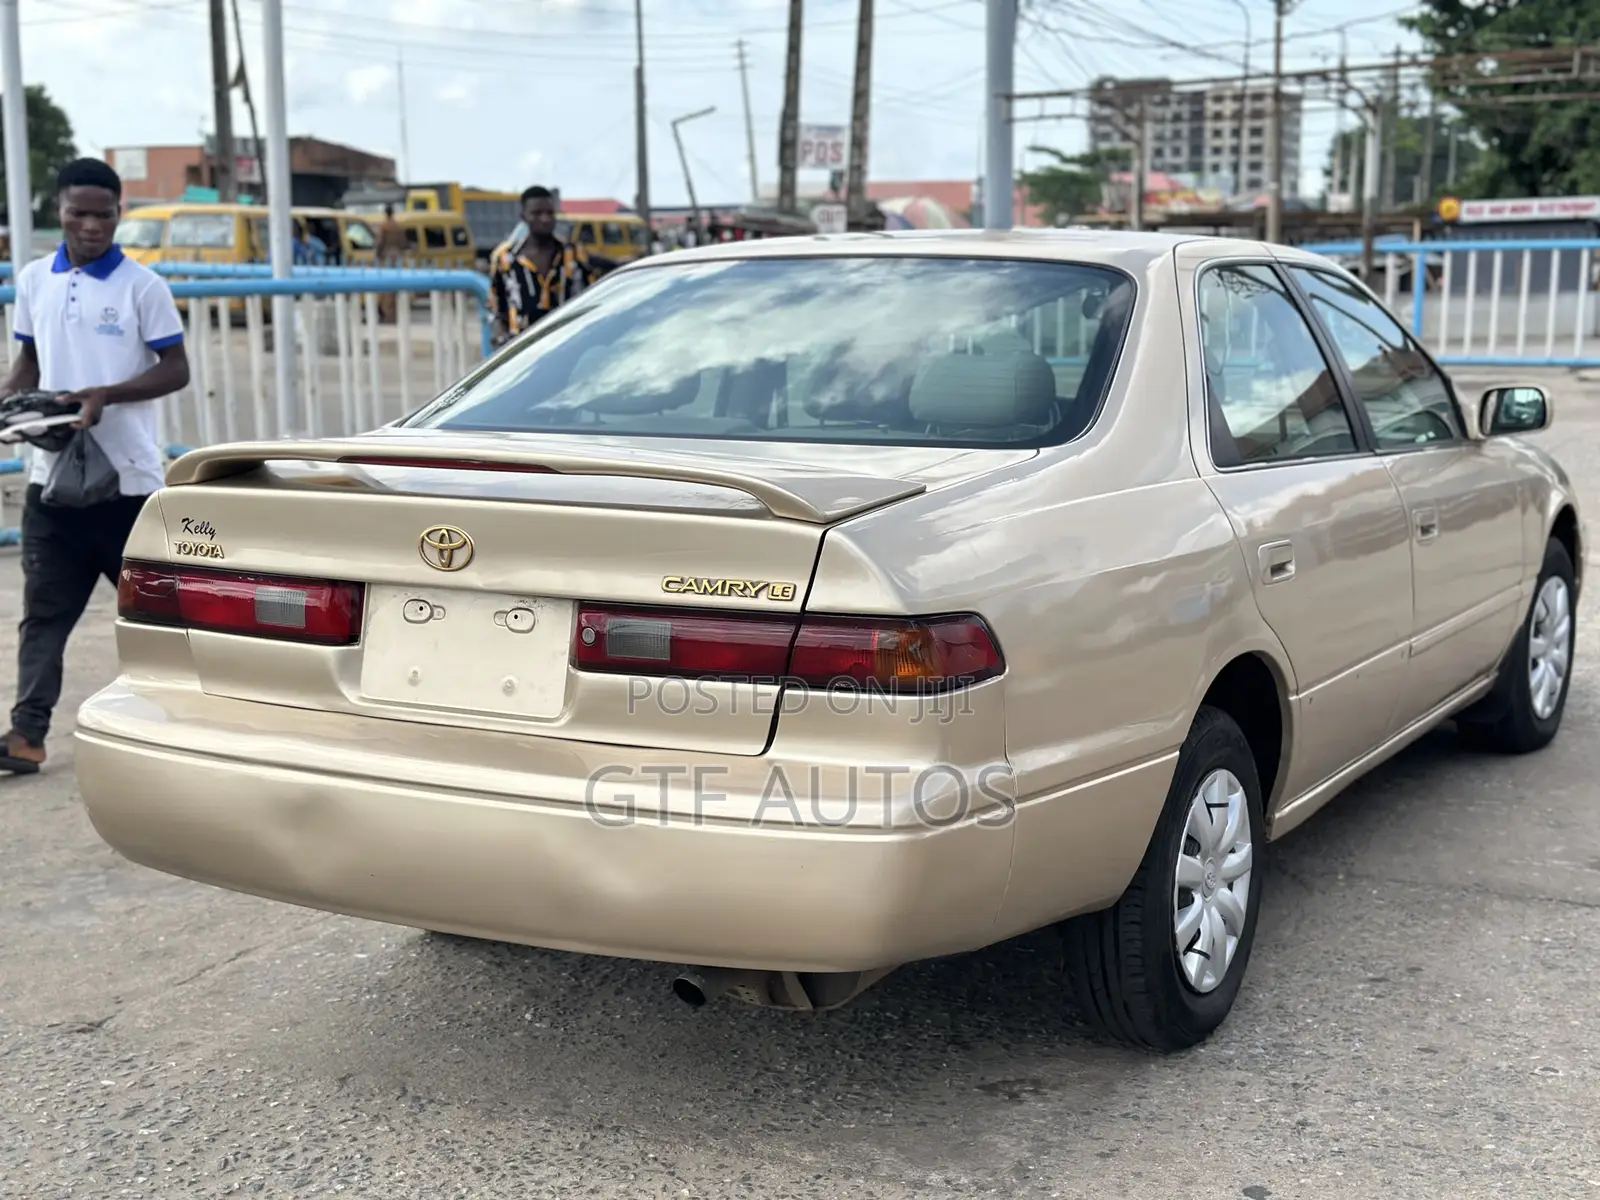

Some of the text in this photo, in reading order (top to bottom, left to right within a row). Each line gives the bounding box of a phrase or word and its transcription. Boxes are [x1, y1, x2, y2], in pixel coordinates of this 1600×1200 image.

[801, 140, 844, 164] POS
[181, 517, 216, 541] Kelly
[174, 541, 225, 559] TOYOTA
[661, 575, 796, 601] CAMRY LE
